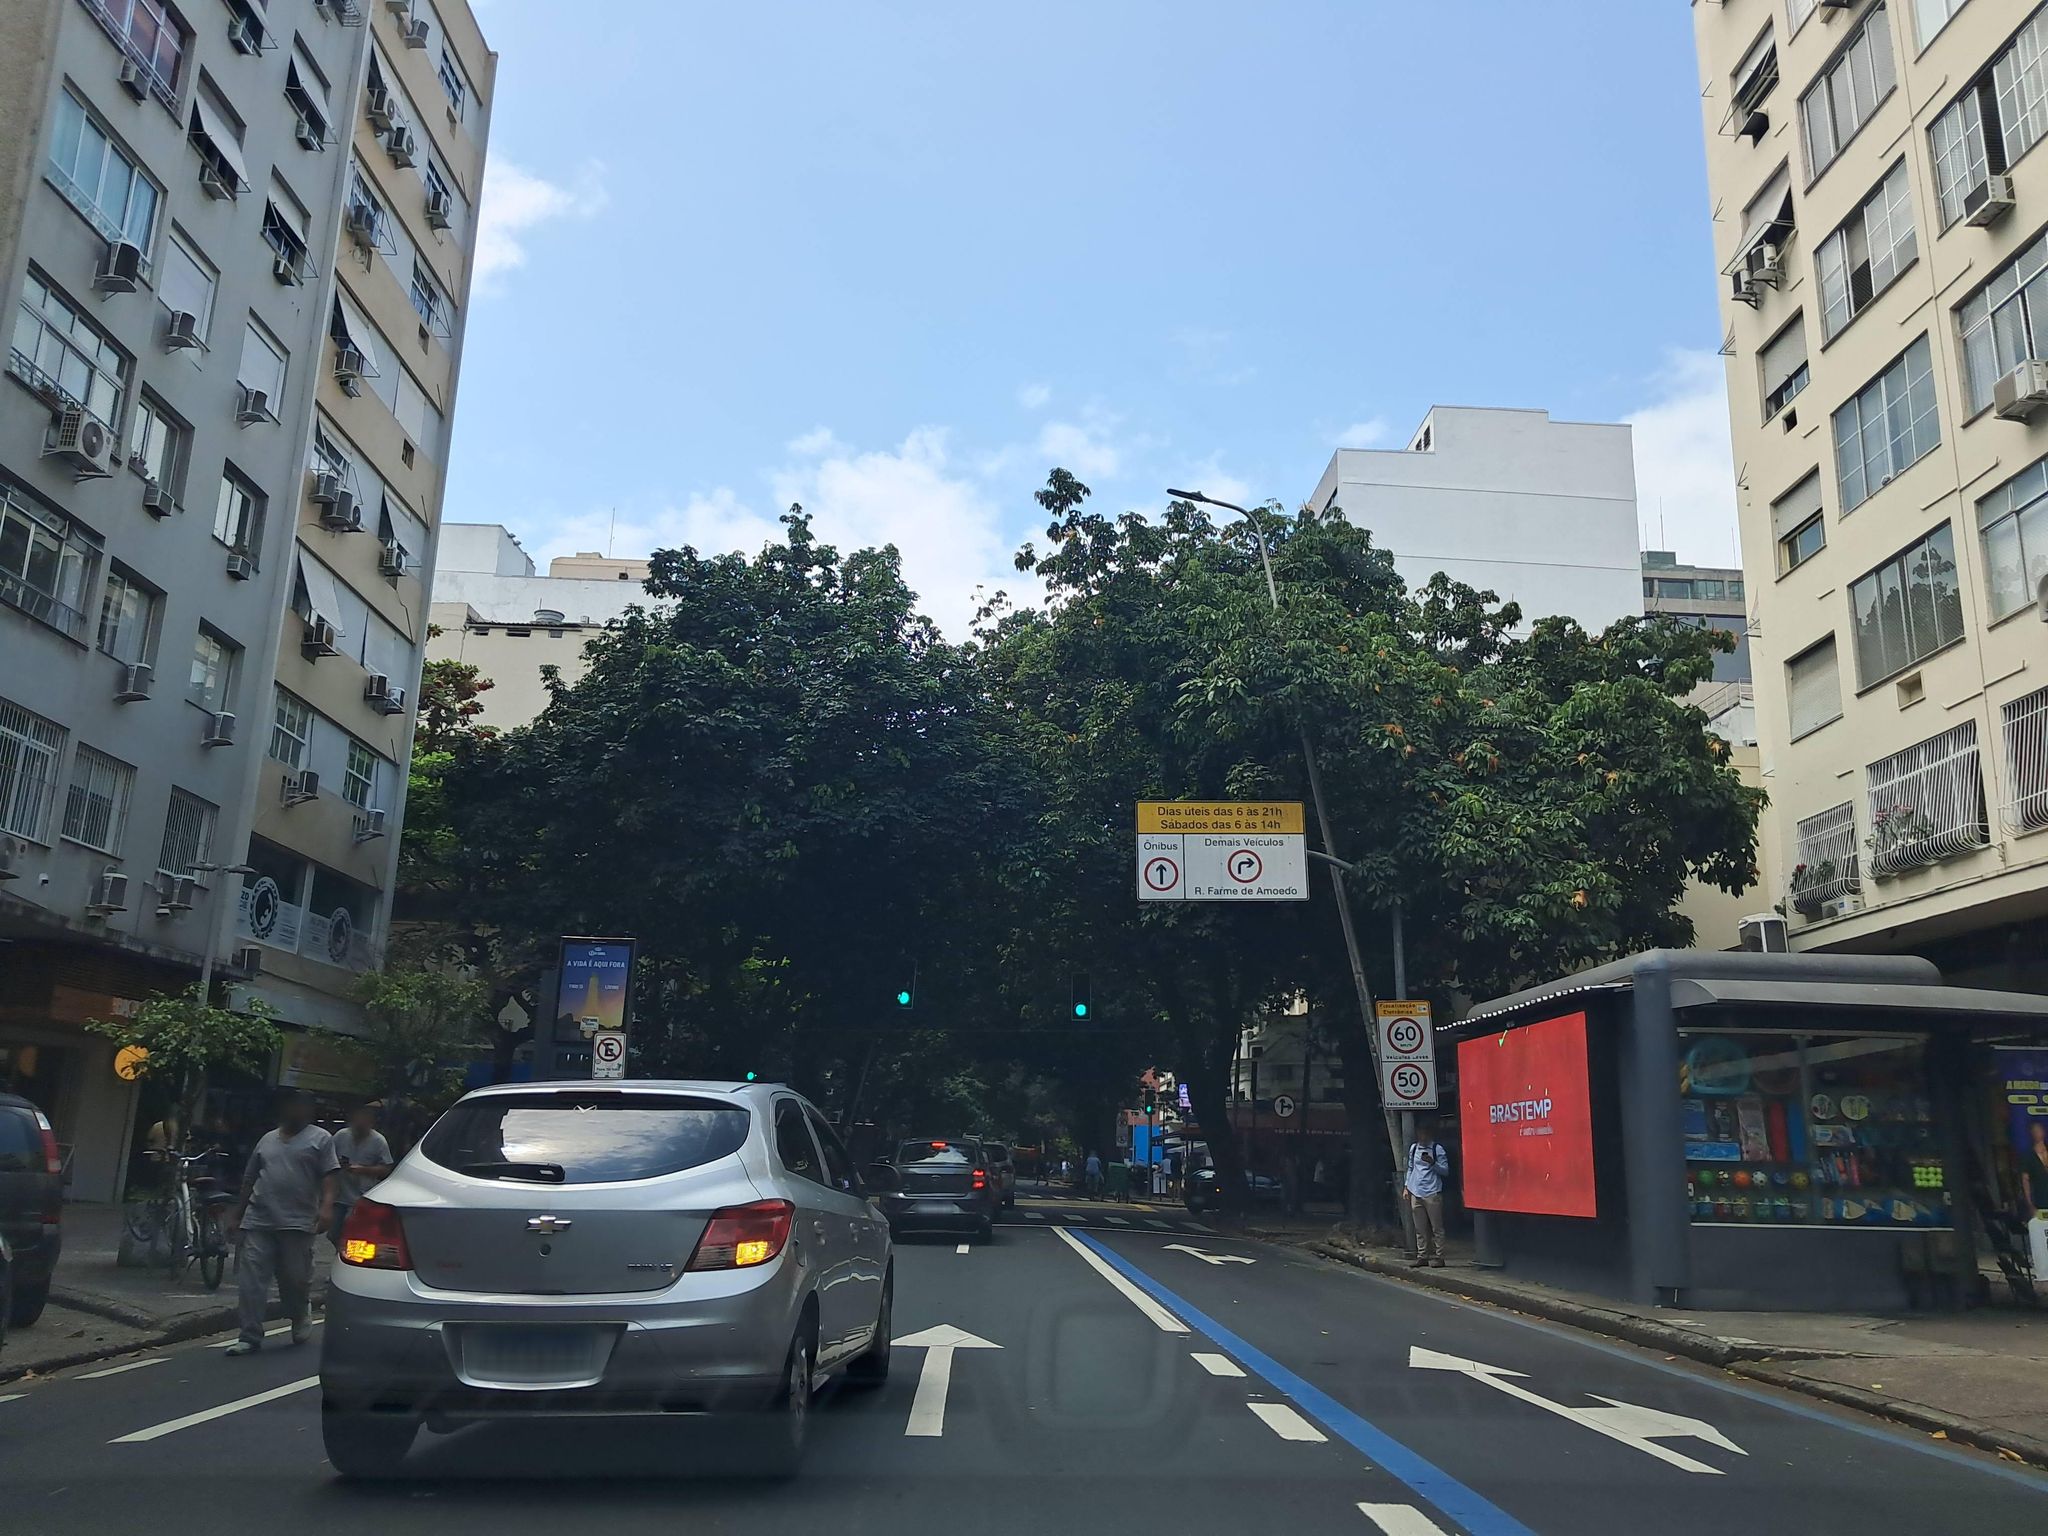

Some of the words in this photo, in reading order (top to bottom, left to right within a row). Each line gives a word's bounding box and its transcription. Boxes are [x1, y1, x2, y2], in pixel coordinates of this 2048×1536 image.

[1157, 806, 1181, 816] Dias
[1184, 806, 1211, 816] úteis
[1213, 807, 1233, 816] das
[1236, 807, 1243, 816] 6
[1247, 807, 1259, 816] às
[1262, 807, 1282, 816] 21h
[1160, 818, 1208, 829] Sábados
[1211, 820, 1231, 829] das
[1234, 820, 1241, 829] 6
[1261, 820, 1281, 829] 14h
[1143, 841, 1178, 850] Ônibus
[1204, 838, 1241, 846] Demais
[1243, 838, 1284, 847] Veículos
[1194, 887, 1205, 895] R.
[1208, 886, 1238, 895] Farme
[1241, 887, 1253, 895] de
[1256, 886, 1298, 896] Amoedo
[1394, 1026, 1416, 1041] 60
[1398, 1072, 1420, 1087] 50
[1490, 1099, 1552, 1123] BRASTEMP
